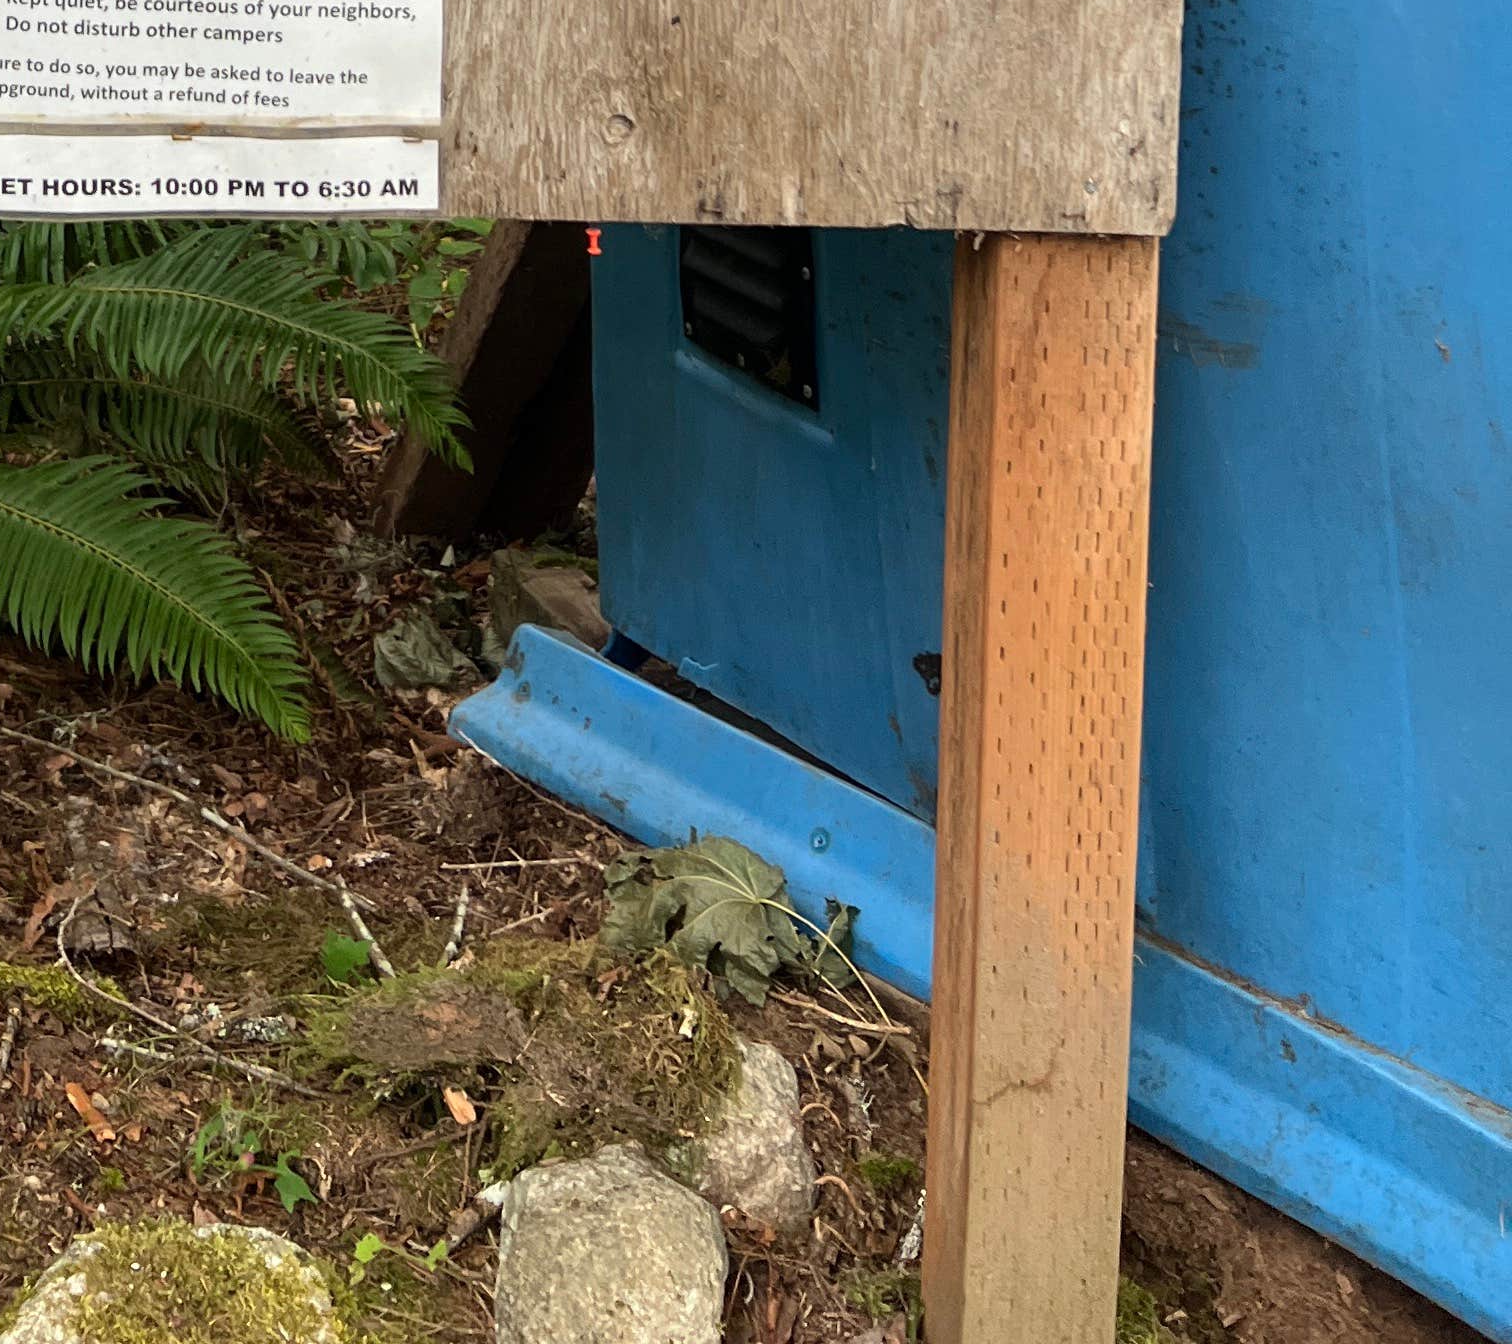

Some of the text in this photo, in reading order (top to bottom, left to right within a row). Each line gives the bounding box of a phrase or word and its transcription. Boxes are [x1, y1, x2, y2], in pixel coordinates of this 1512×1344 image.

[42, 178, 140, 196] HOURS:
[151, 178, 218, 195] 10:00
[228, 179, 264, 197] PM
[273, 181, 309, 197] TO
[318, 180, 371, 198] 6:30
[379, 179, 418, 196] AM
